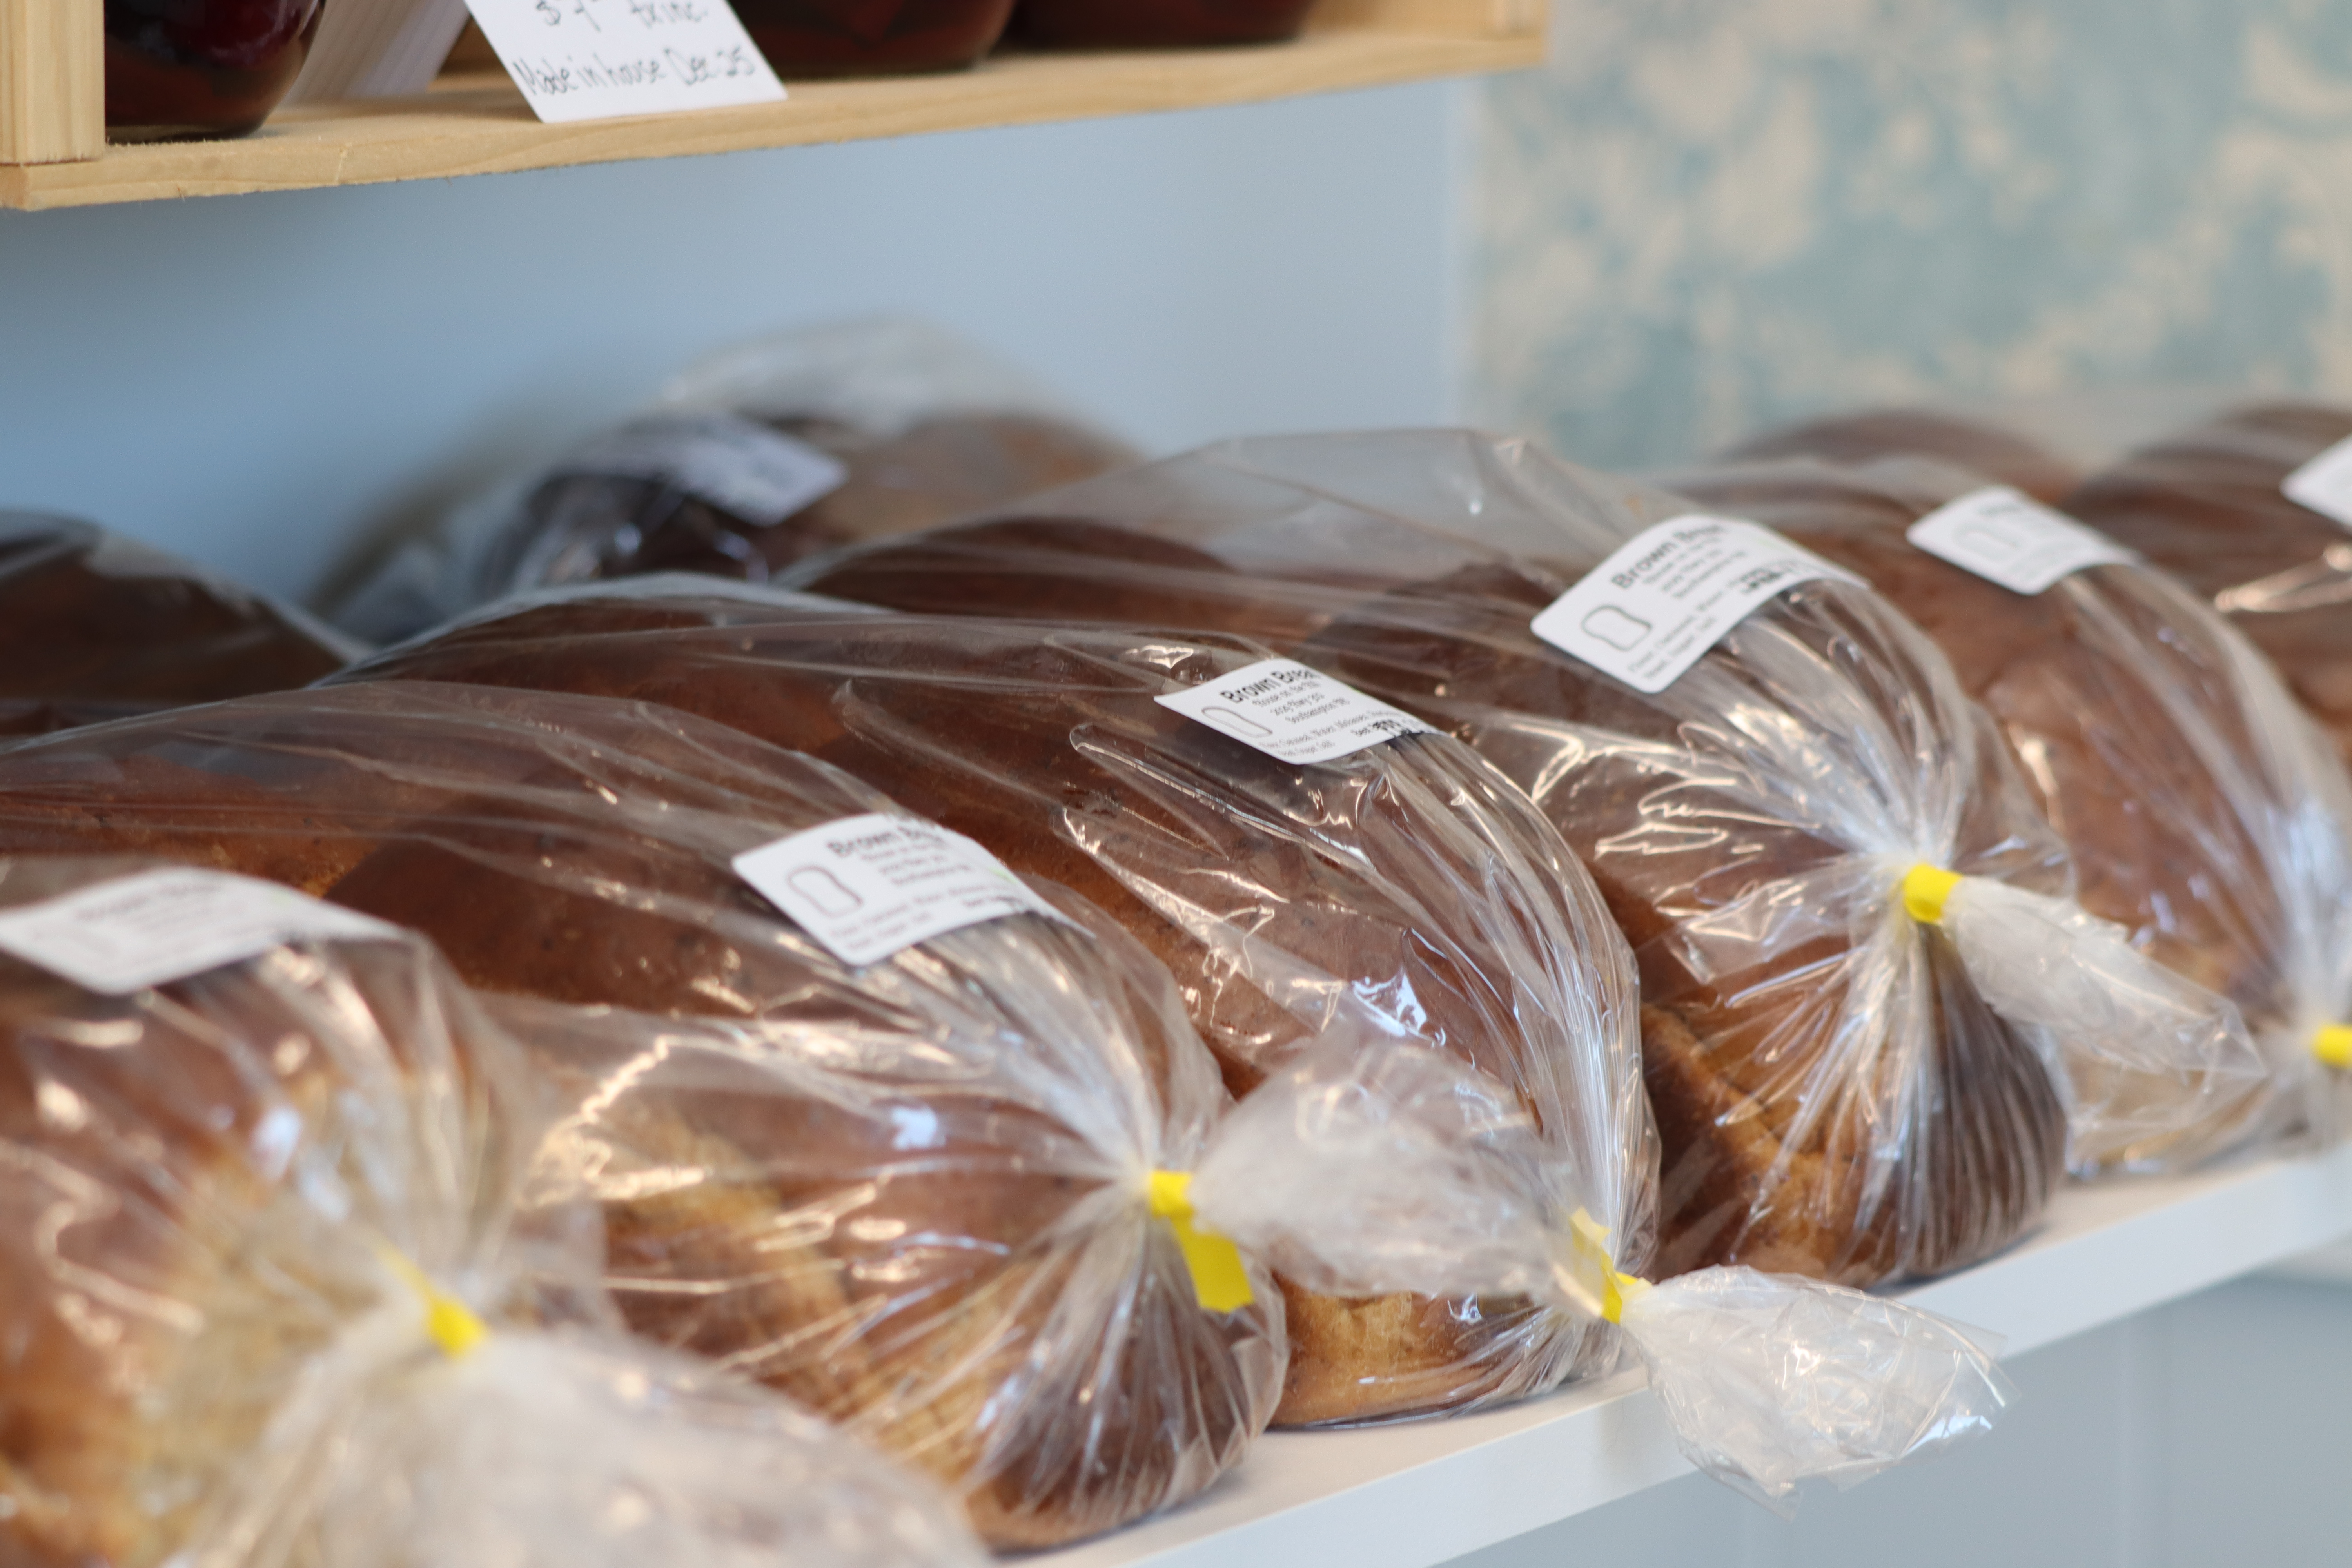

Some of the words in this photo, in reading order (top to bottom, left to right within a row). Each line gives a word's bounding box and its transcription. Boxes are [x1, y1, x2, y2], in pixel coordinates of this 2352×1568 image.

[511, 57, 580, 95] Made
[592, 51, 666, 86] house
[1611, 541, 1679, 589] Brown
[1219, 678, 1282, 704] Brown
